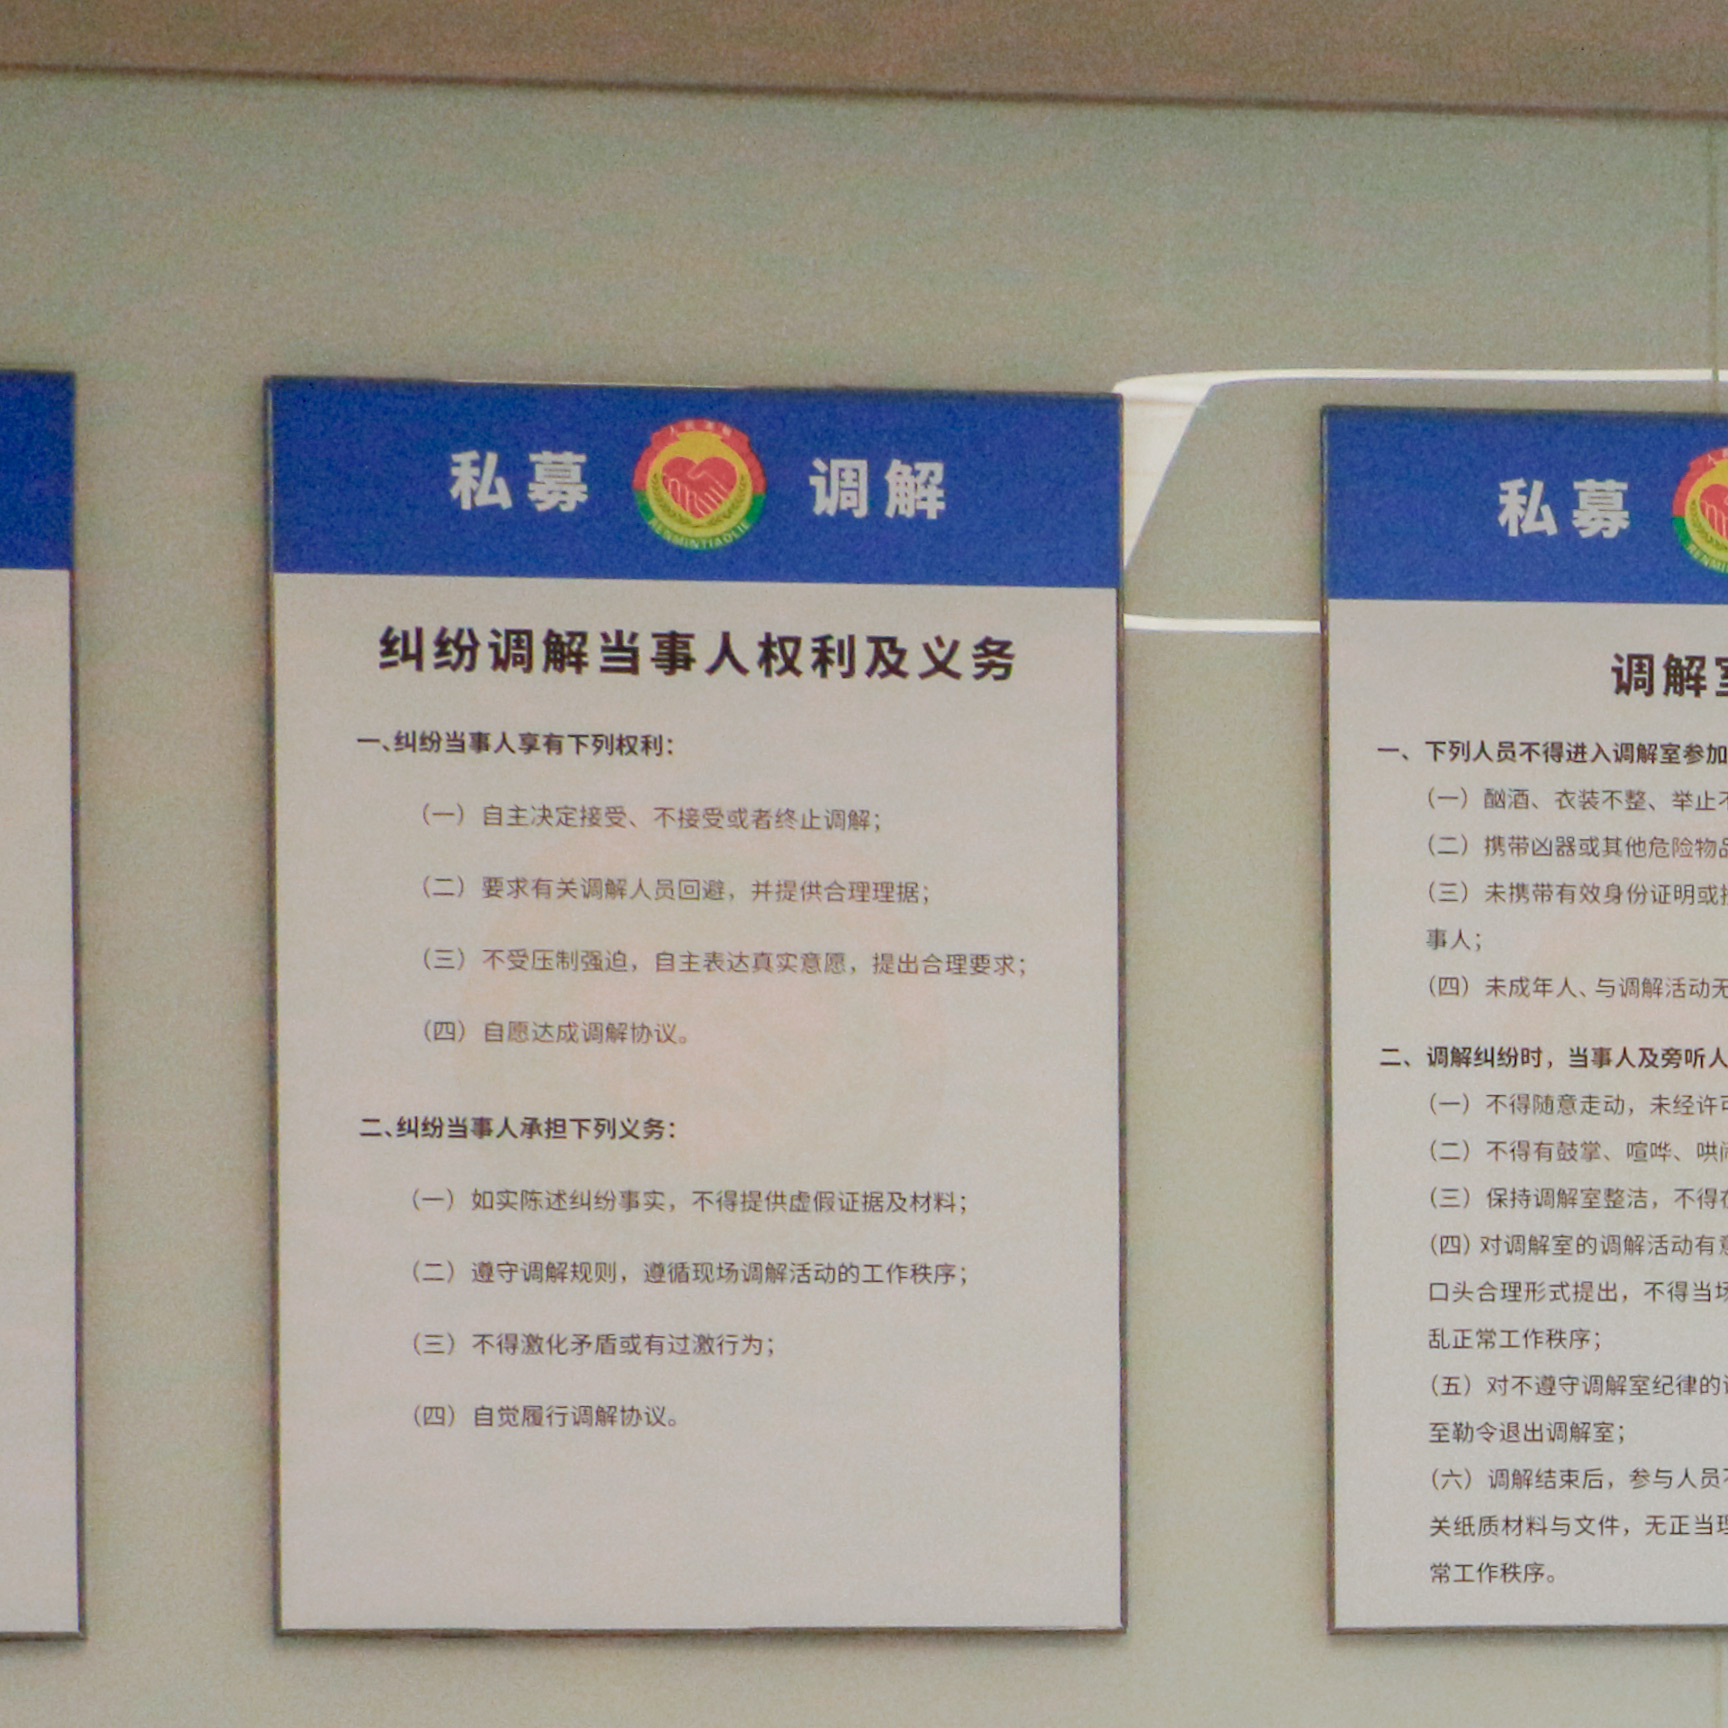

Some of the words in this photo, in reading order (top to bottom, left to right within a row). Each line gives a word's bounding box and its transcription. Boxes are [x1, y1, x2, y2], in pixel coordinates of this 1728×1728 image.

[450, 450, 588, 512] 私募
[809, 458, 945, 519] 调解
[1498, 478, 1629, 538] 私募
[379, 625, 1015, 682] 纠纷调解当事人权利及义务
[1427, 928, 1481, 950] 事人；
[1429, 1328, 1600, 1351] 乱正常工作秩序；
[1429, 1421, 1624, 1444] 至勒令退出调解室；
[1430, 1562, 1557, 1584] 常工作秩序。
